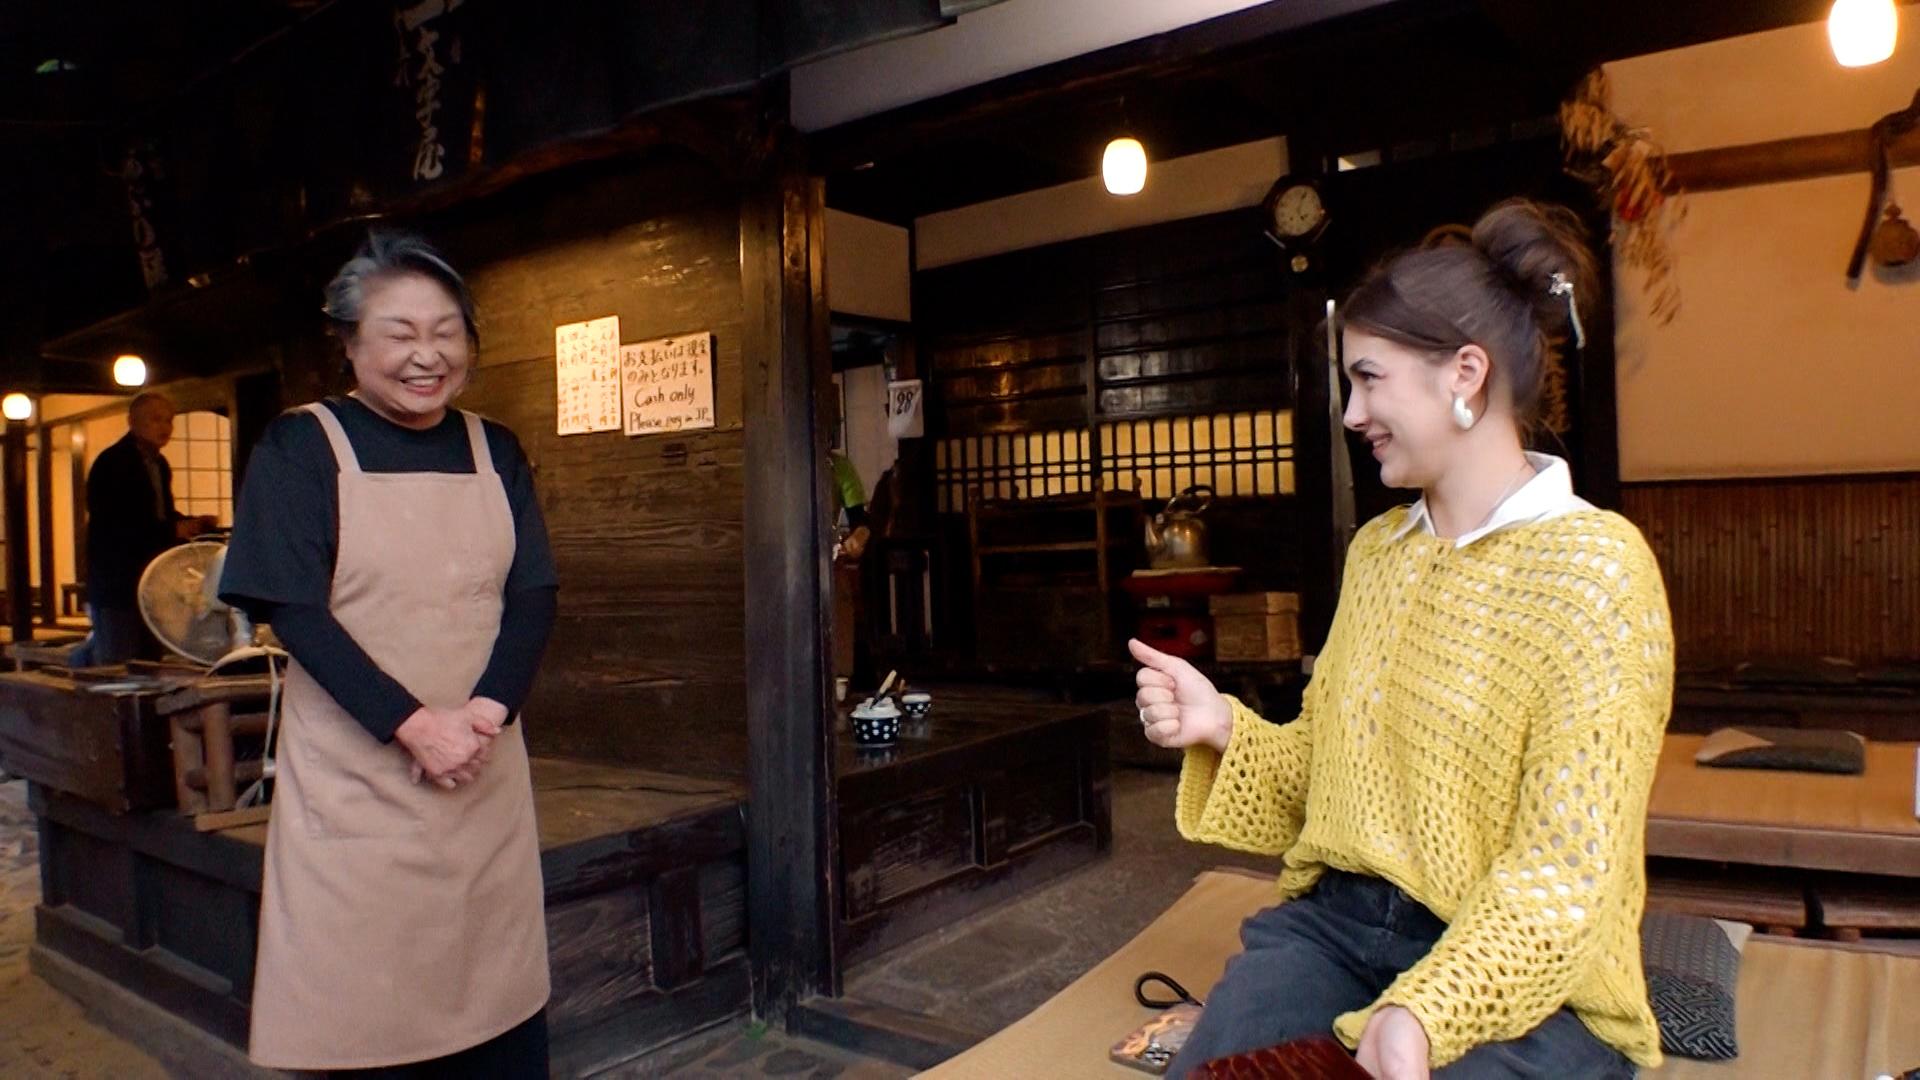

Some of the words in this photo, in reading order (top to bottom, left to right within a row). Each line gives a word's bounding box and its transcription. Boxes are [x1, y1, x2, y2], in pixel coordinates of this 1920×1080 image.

[634, 386, 665, 408] Cash
[669, 383, 695, 406] only
[896, 391, 914, 415] 28
[629, 411, 662, 432] Please
